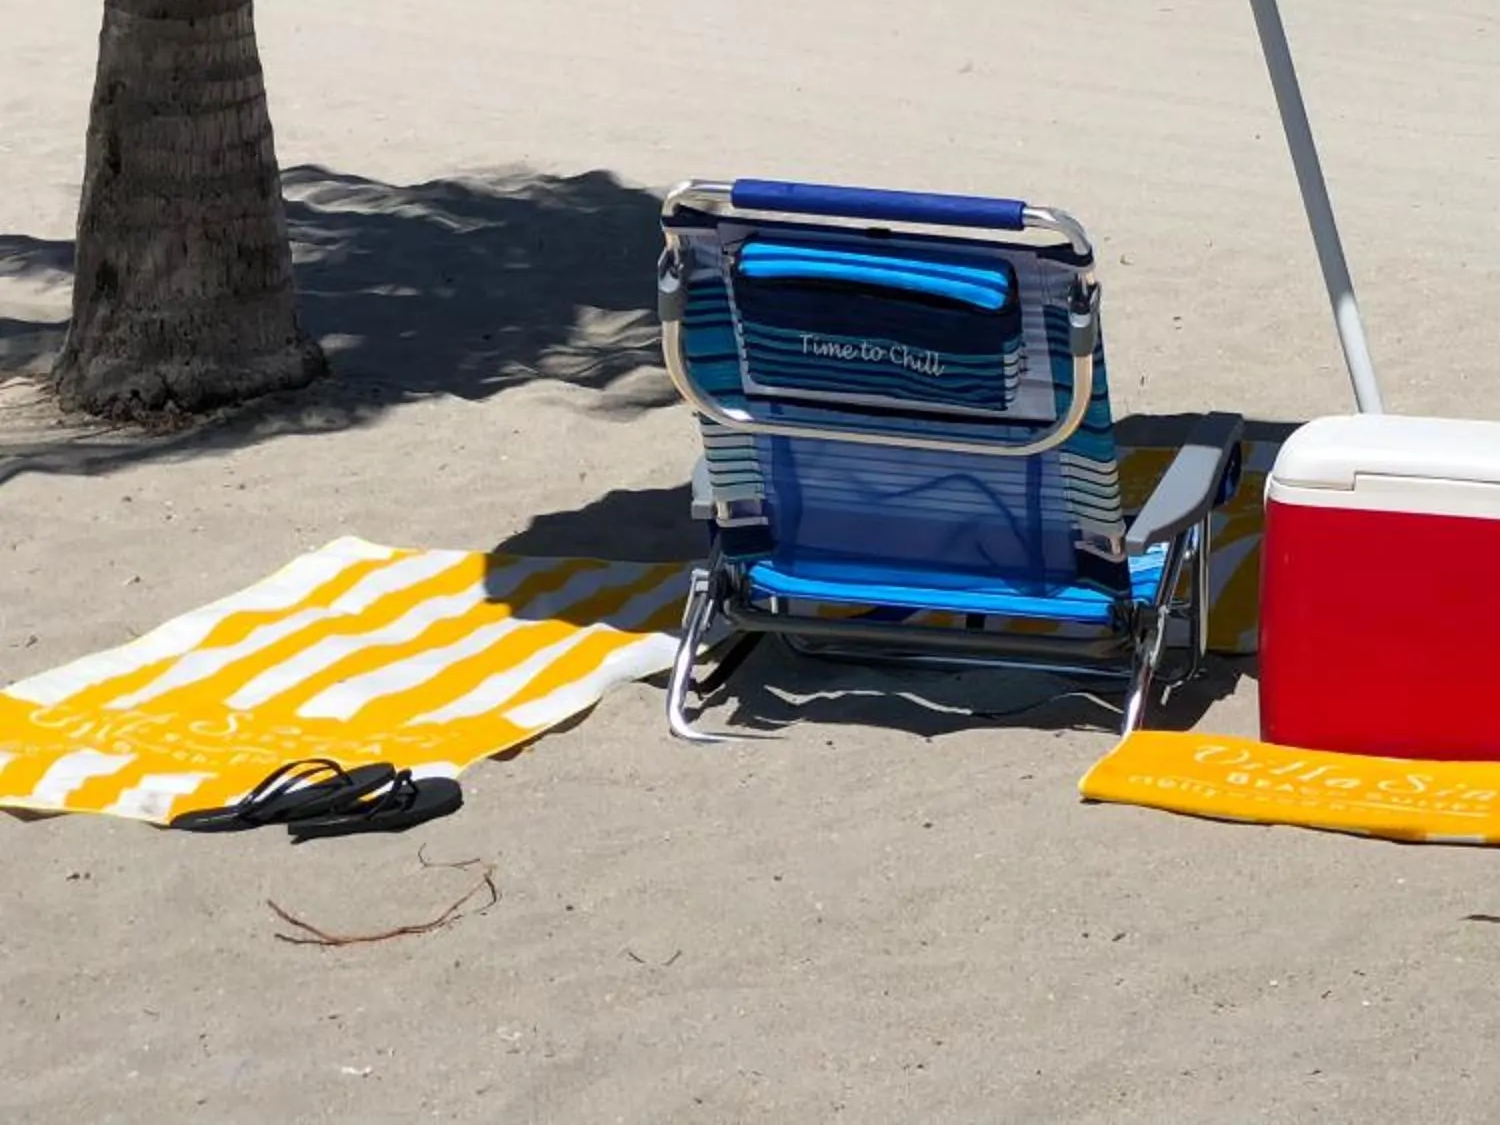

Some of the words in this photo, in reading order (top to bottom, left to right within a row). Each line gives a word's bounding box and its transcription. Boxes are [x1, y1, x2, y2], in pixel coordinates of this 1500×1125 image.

[800, 333, 857, 360] Time
[860, 339, 887, 362] to
[890, 345, 945, 376] Chill
